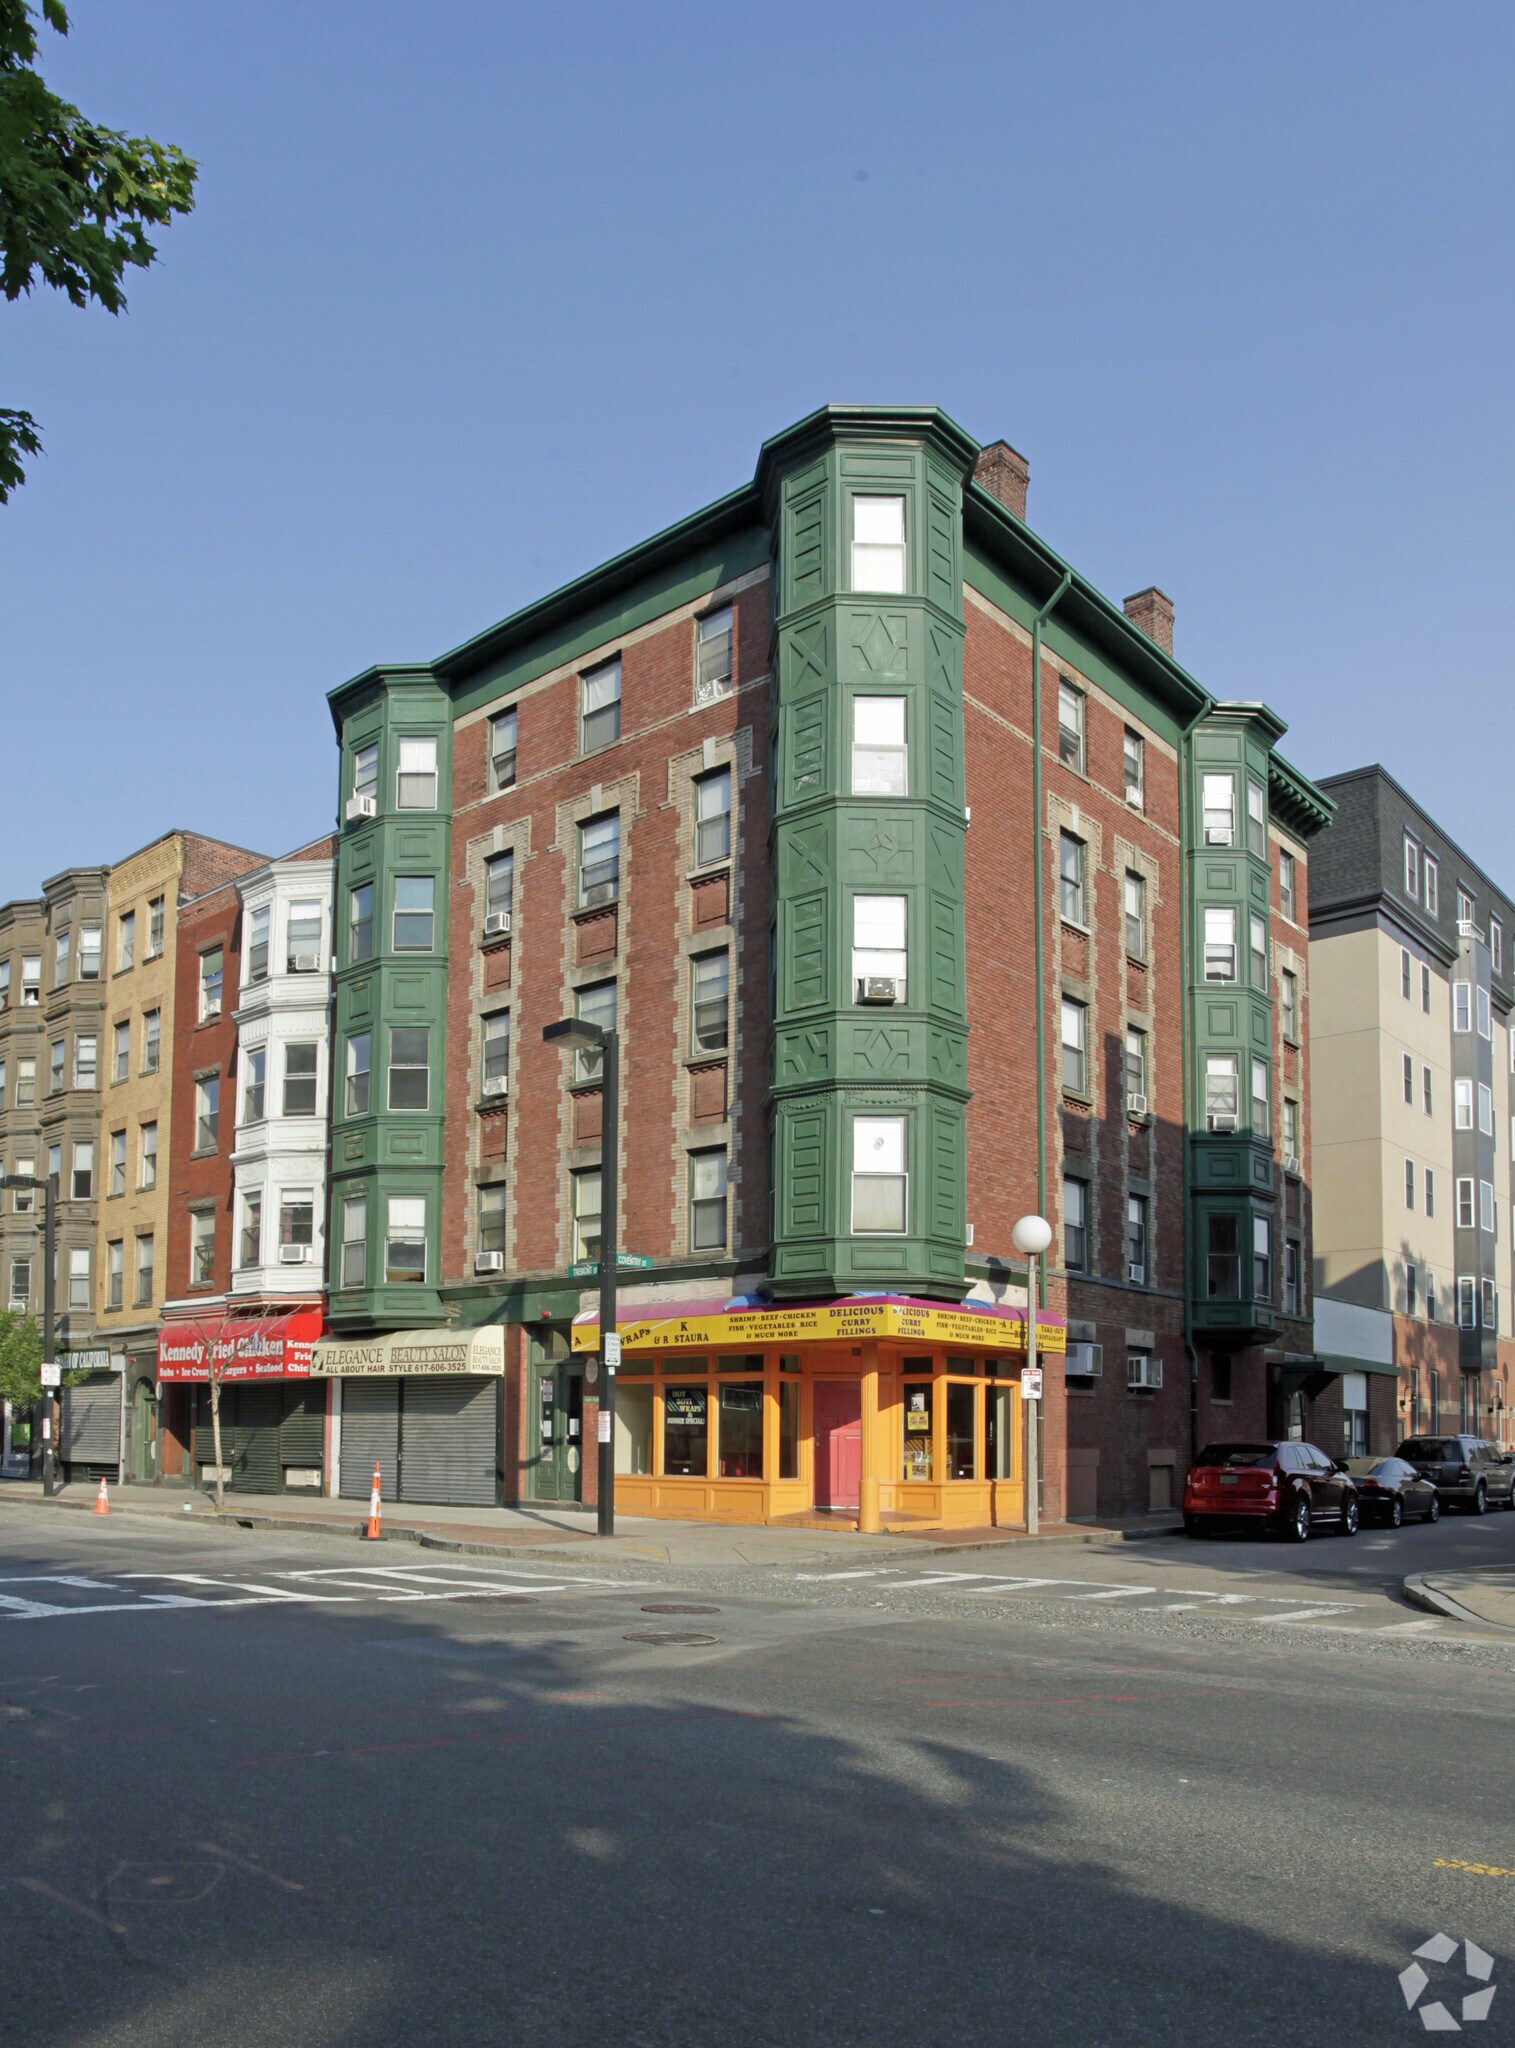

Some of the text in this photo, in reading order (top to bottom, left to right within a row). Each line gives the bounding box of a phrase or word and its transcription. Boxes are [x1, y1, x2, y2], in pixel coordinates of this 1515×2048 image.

[618, 1256, 641, 1267] COVENTRY
[573, 1265, 592, 1276] TREMONT
[783, 1312, 816, 1320] CHICKEN
[830, 1307, 884, 1317] DELICIOUS
[893, 1308, 930, 1317] LICIOUS
[937, 1313, 957, 1321] SHRIMP
[681, 1321, 688, 1332] K
[749, 1322, 795, 1330] VEGETABLES
[841, 1318, 871, 1326] CURRY
[901, 1318, 921, 1327] CURRY
[837, 1327, 876, 1336] FILLINGS
[897, 1327, 925, 1336] FILLINGS
[952, 1323, 983, 1333] VEGETABLES
[1041, 1325, 1064, 1335] TAKE-OUT
[574, 1336, 582, 1347] A
[160, 1341, 204, 1364] Kennedy
[206, 1339, 235, 1359] ried
[326, 1346, 468, 1365] ELEGANCE BEAUTY SALON
[473, 1345, 501, 1356] ELEGANCE
[71, 1352, 79, 1369] OF
[80, 1350, 110, 1368] CALIFORNIA
[473, 1355, 501, 1365] BEAUTY SALON
[160, 1368, 174, 1376] Subs
[181, 1367, 190, 1377] Ice
[256, 1362, 284, 1373] Seafood
[367, 1365, 385, 1373] HAIR
[389, 1364, 413, 1373] STYLE
[414, 1362, 467, 1372] 617-606-3525
[472, 1364, 501, 1372] 617-606-3525
[667, 1417, 685, 1425] DINNER
